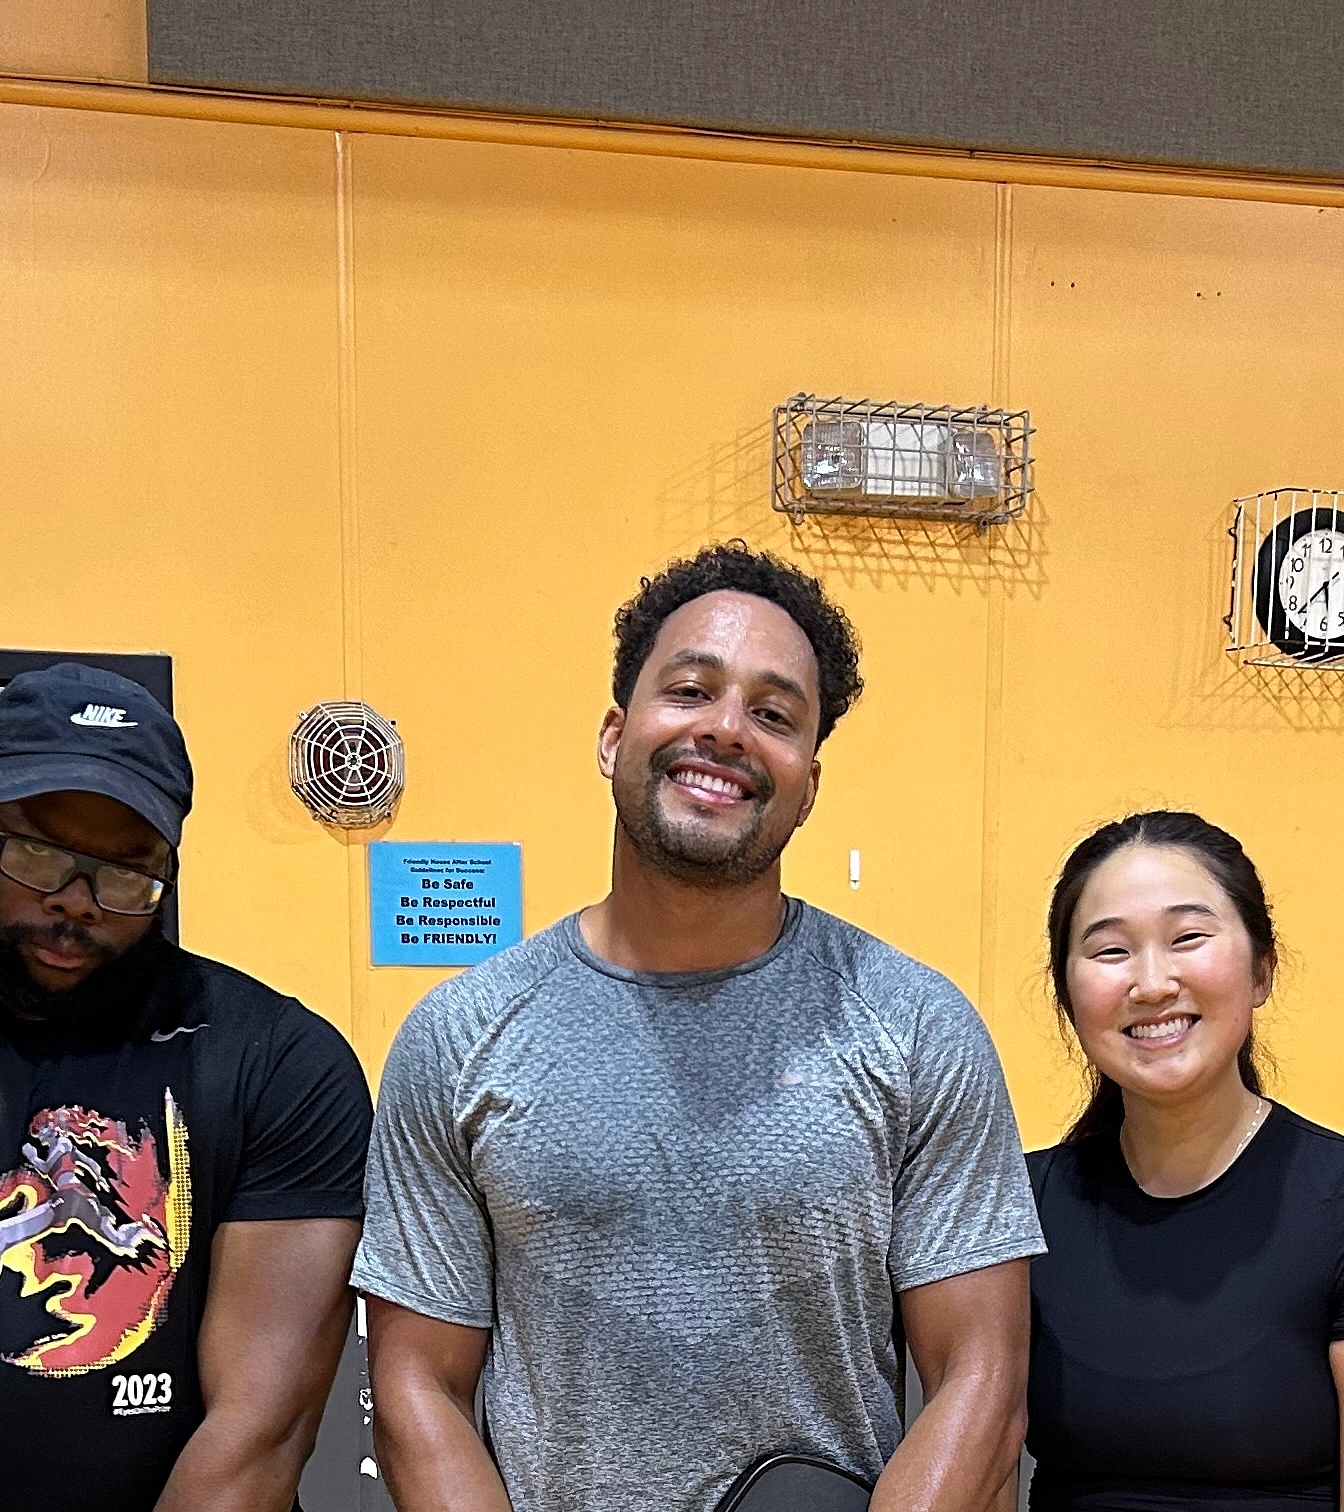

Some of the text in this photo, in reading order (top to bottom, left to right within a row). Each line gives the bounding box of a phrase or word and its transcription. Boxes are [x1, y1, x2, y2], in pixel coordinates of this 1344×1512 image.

[1302, 543, 1312, 558] 11
[1319, 538, 1333, 553] 12
[1290, 557, 1305, 573] 10
[1288, 595, 1298, 611] 8
[1320, 616, 1328, 631] 6
[84, 703, 126, 723] NIKE
[422, 879, 474, 889] Be Safe
[400, 897, 495, 910] Be Respectful
[396, 915, 501, 928] Be Responsible
[401, 934, 497, 944] Be FRIENDLY!
[112, 1372, 172, 1406] 2023
